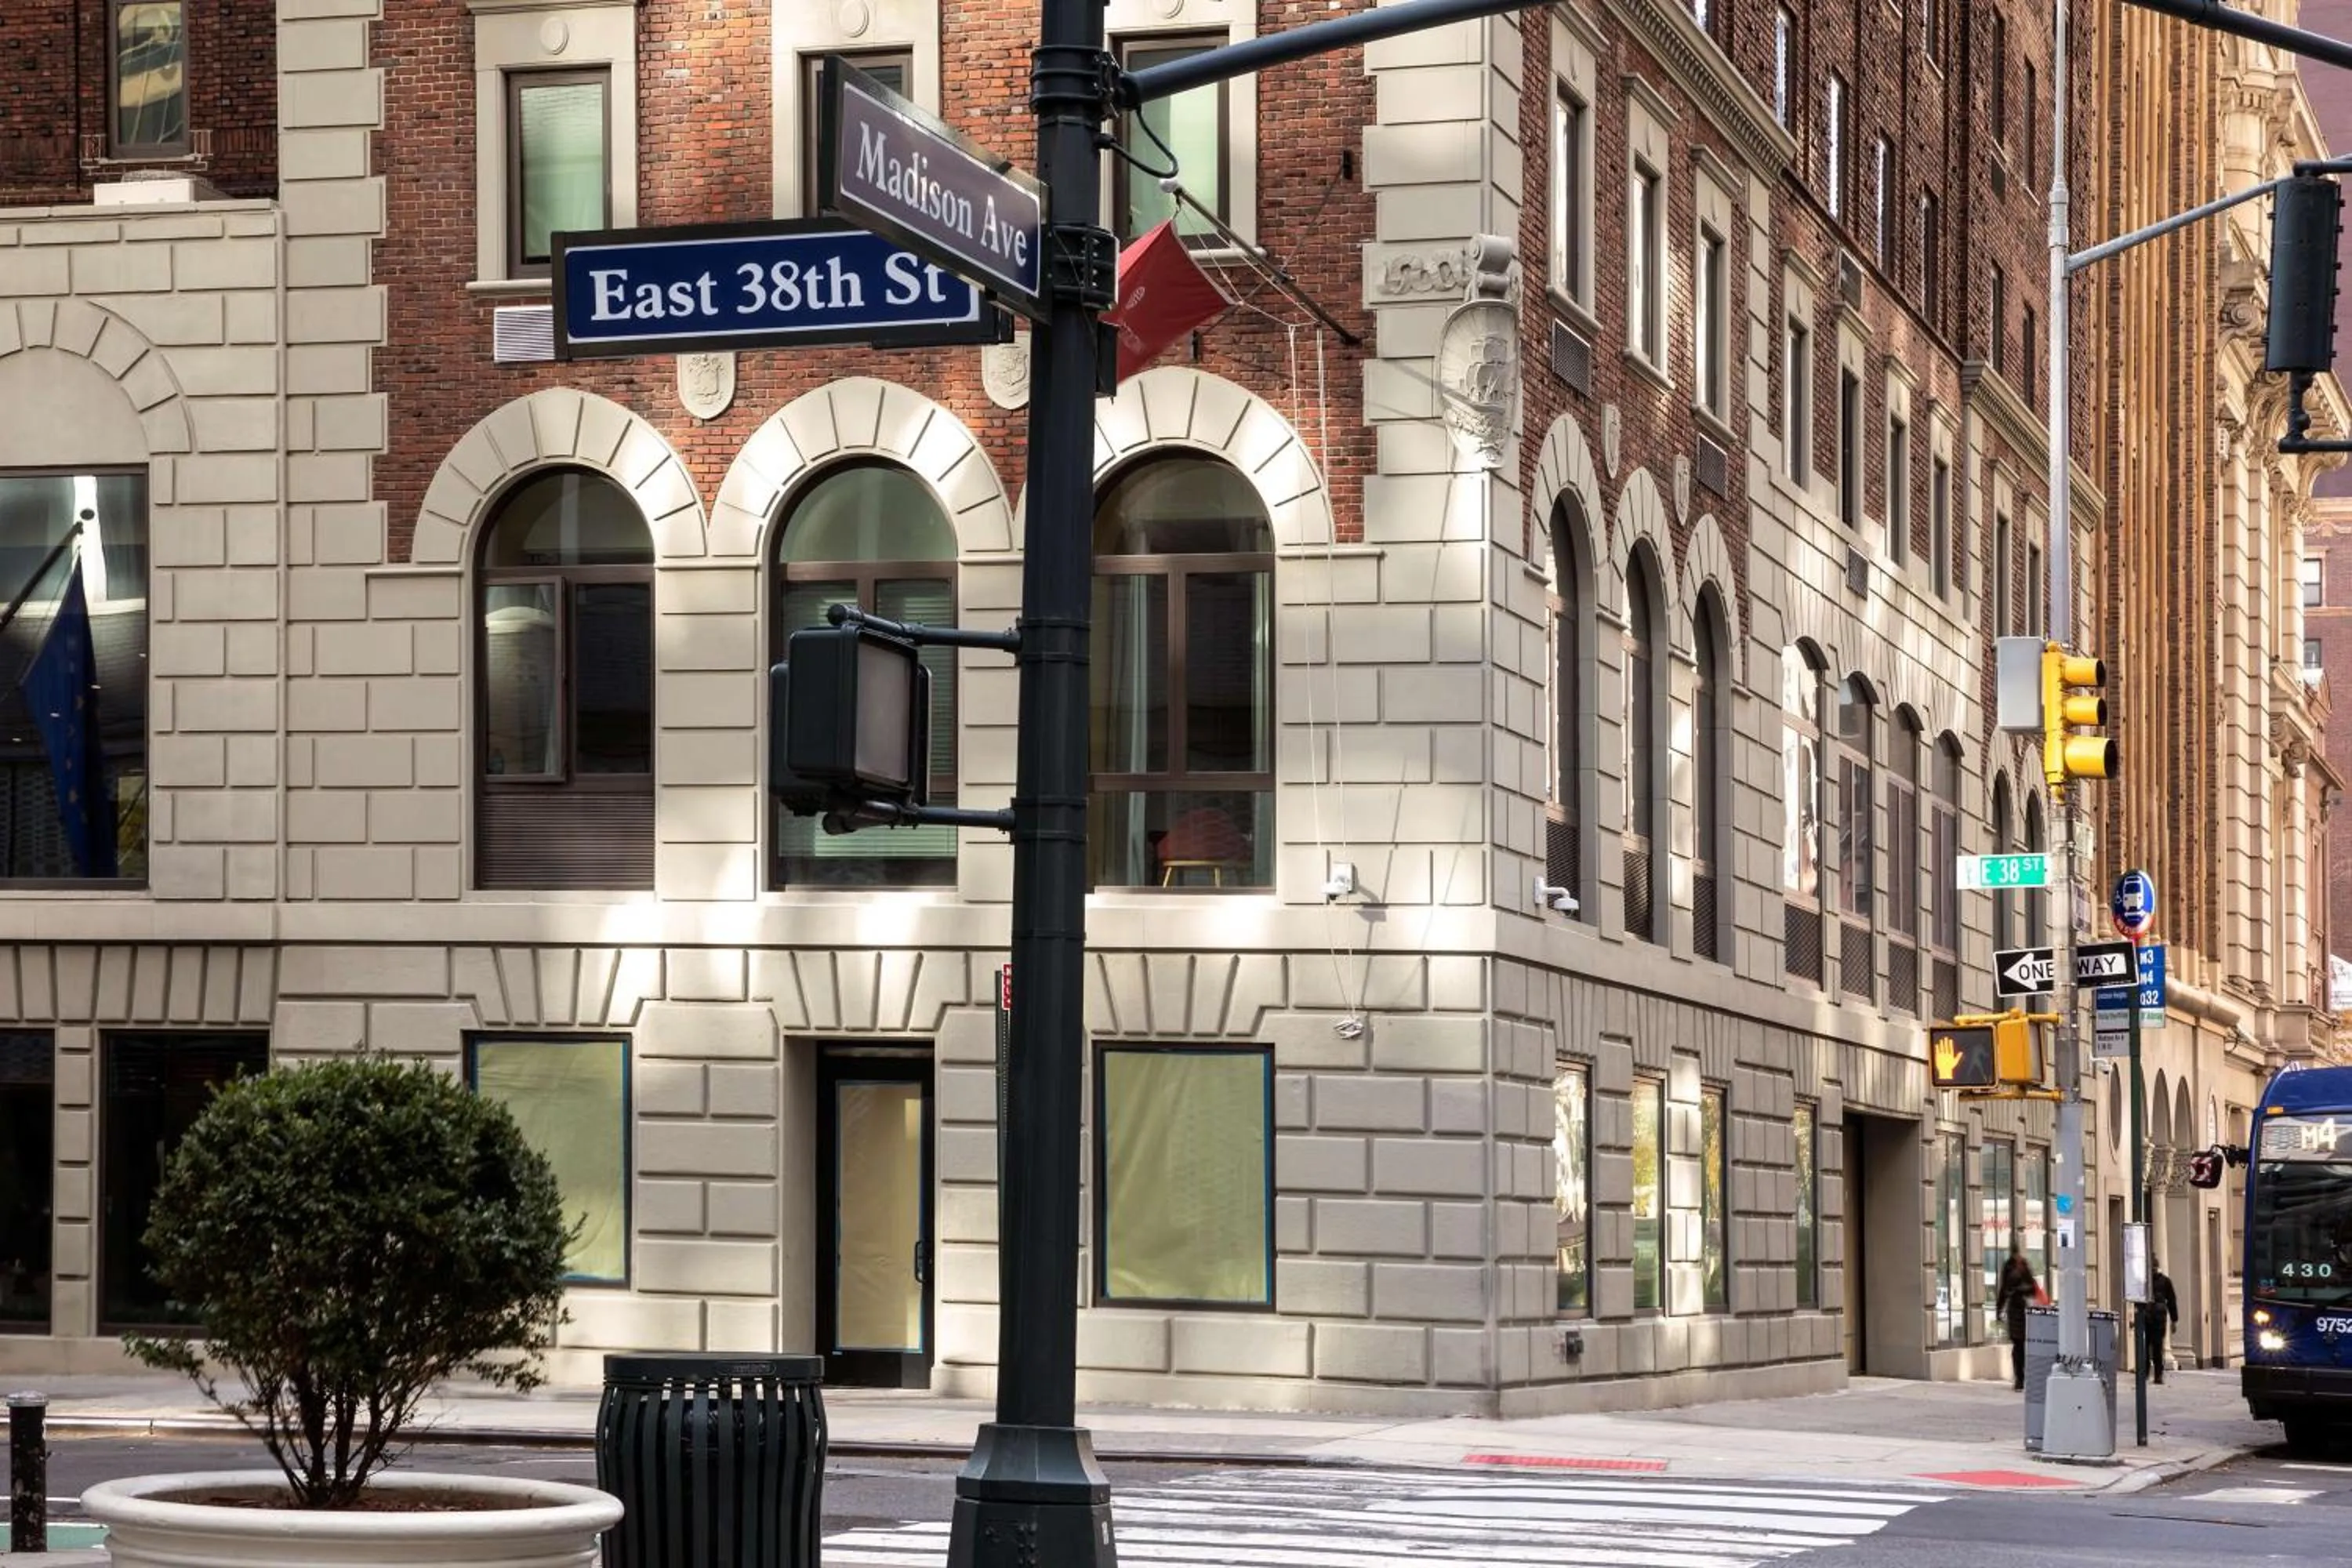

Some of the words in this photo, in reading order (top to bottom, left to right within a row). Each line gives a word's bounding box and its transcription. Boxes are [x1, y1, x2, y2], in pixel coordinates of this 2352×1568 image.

[855, 122, 975, 240] Madison
[980, 194, 1028, 267] Ave
[589, 269, 719, 321] East
[736, 256, 864, 314] 38th
[884, 252, 946, 305] St
[1980, 859, 1992, 884] E
[1998, 858, 2020, 884] 38
[2023, 857, 2042, 872] ST
[2018, 962, 2054, 980] ONE
[2078, 956, 2116, 975] WAY
[2140, 949, 2154, 965] M3
[2140, 970, 2154, 985] M4
[2140, 990, 2158, 1006] Q32
[2300, 1117, 2337, 1150] M4
